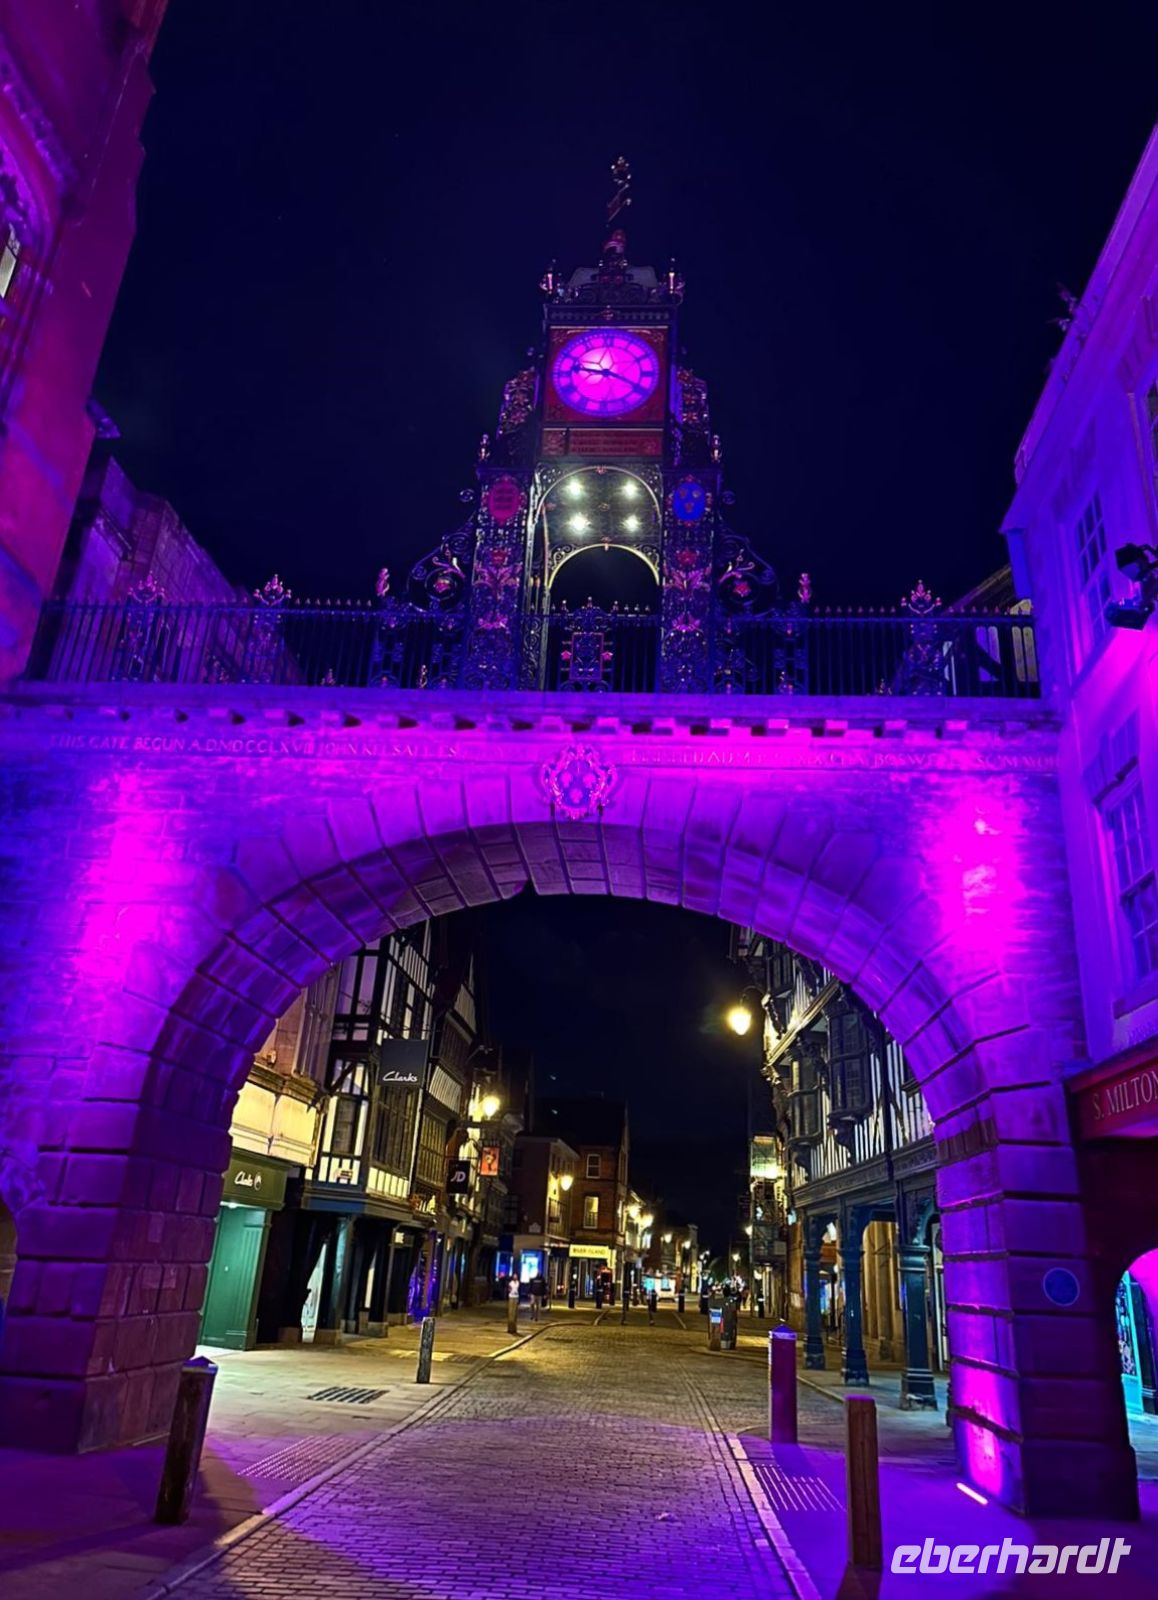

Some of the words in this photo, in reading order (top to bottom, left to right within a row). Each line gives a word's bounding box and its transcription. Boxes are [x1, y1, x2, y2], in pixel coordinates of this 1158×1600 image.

[133, 737, 185, 752] BEGUN
[382, 1070, 418, 1083] Clarks
[450, 1171, 466, 1182] JD
